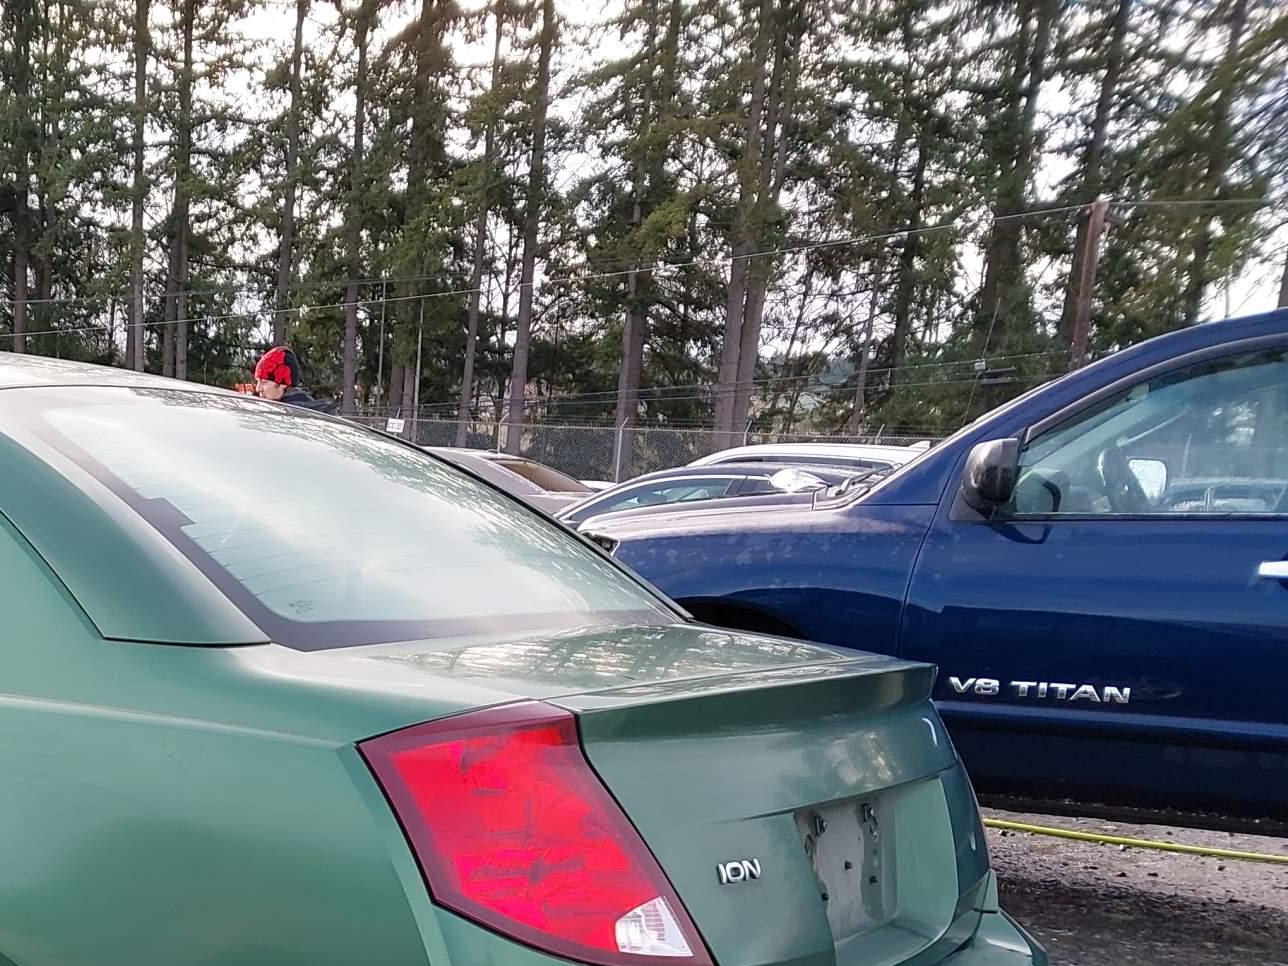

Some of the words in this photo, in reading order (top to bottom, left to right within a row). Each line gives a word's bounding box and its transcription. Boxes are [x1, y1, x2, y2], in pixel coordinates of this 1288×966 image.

[948, 676, 1000, 696] V8
[1011, 680, 1131, 704] TITAN
[718, 858, 762, 885] ION
